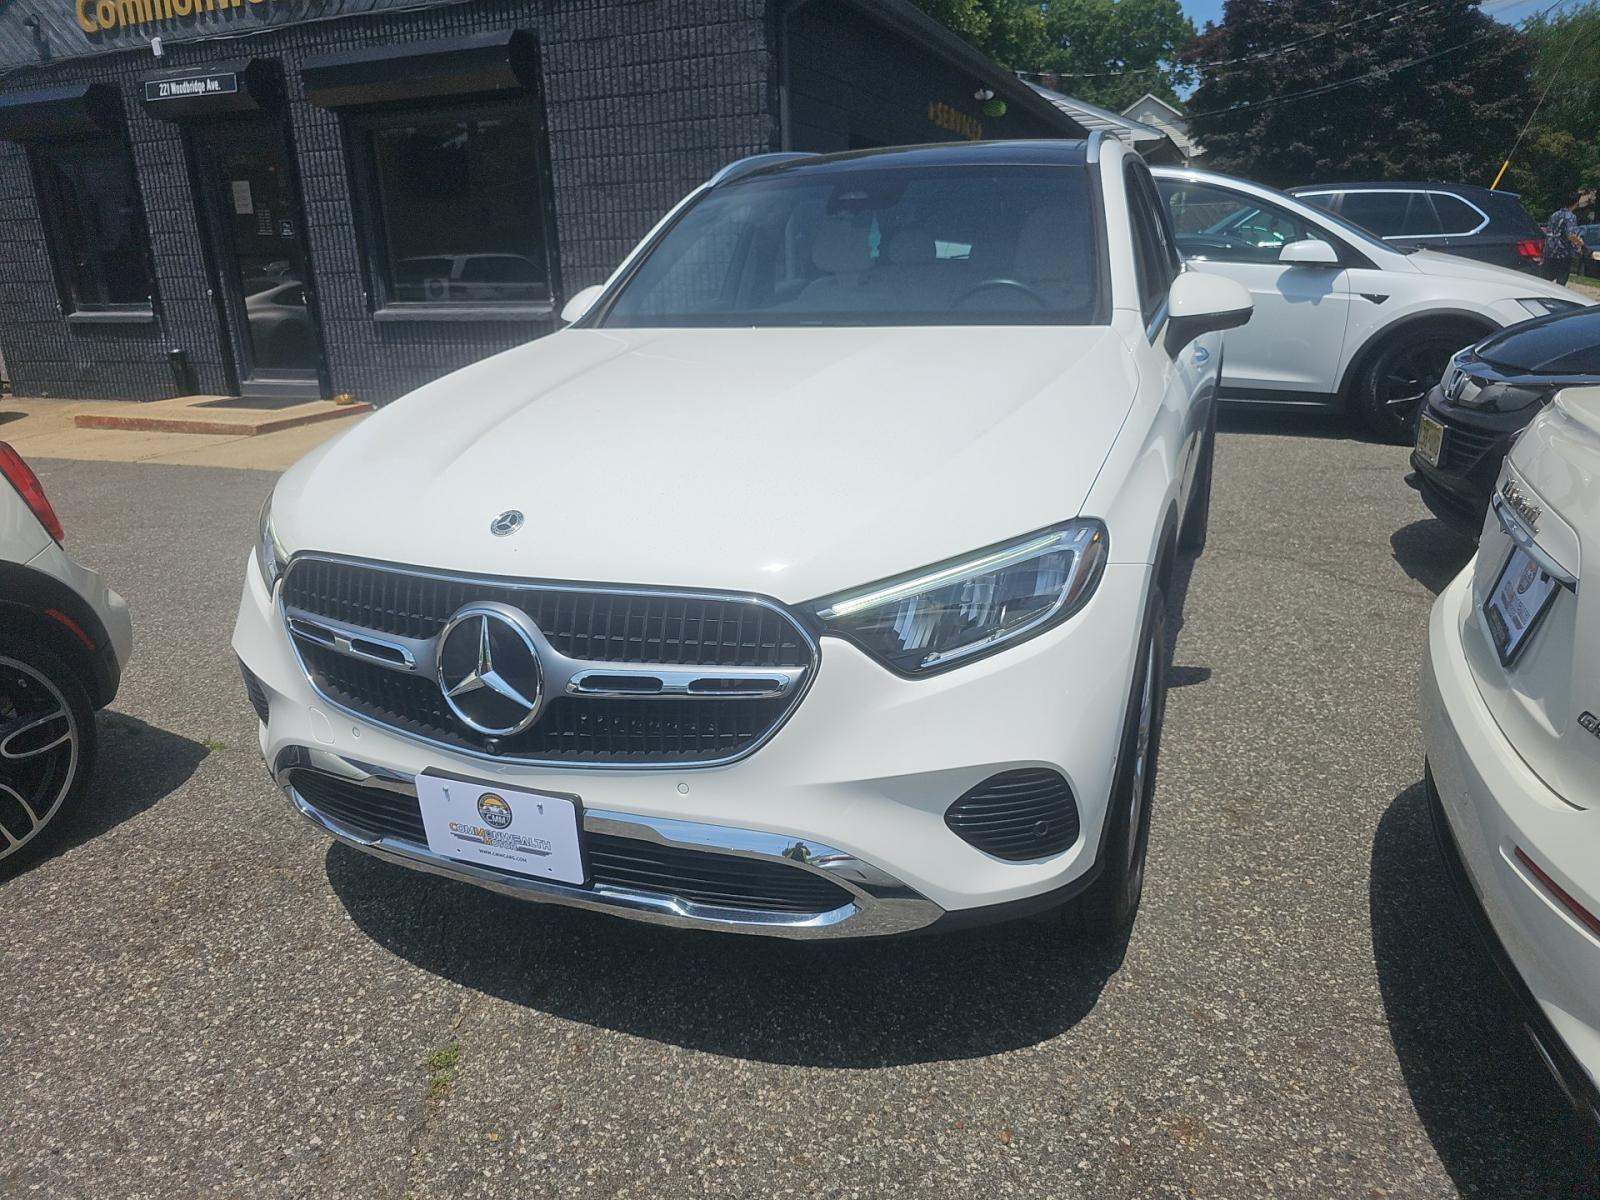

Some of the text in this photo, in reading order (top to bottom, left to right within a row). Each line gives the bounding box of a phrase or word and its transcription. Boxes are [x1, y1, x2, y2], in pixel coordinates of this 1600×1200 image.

[75, 0, 263, 33] Commo
[170, 80, 206, 95] Woodbridge
[206, 78, 221, 92] Ave.
[448, 821, 552, 851] COMMONWEALTH
